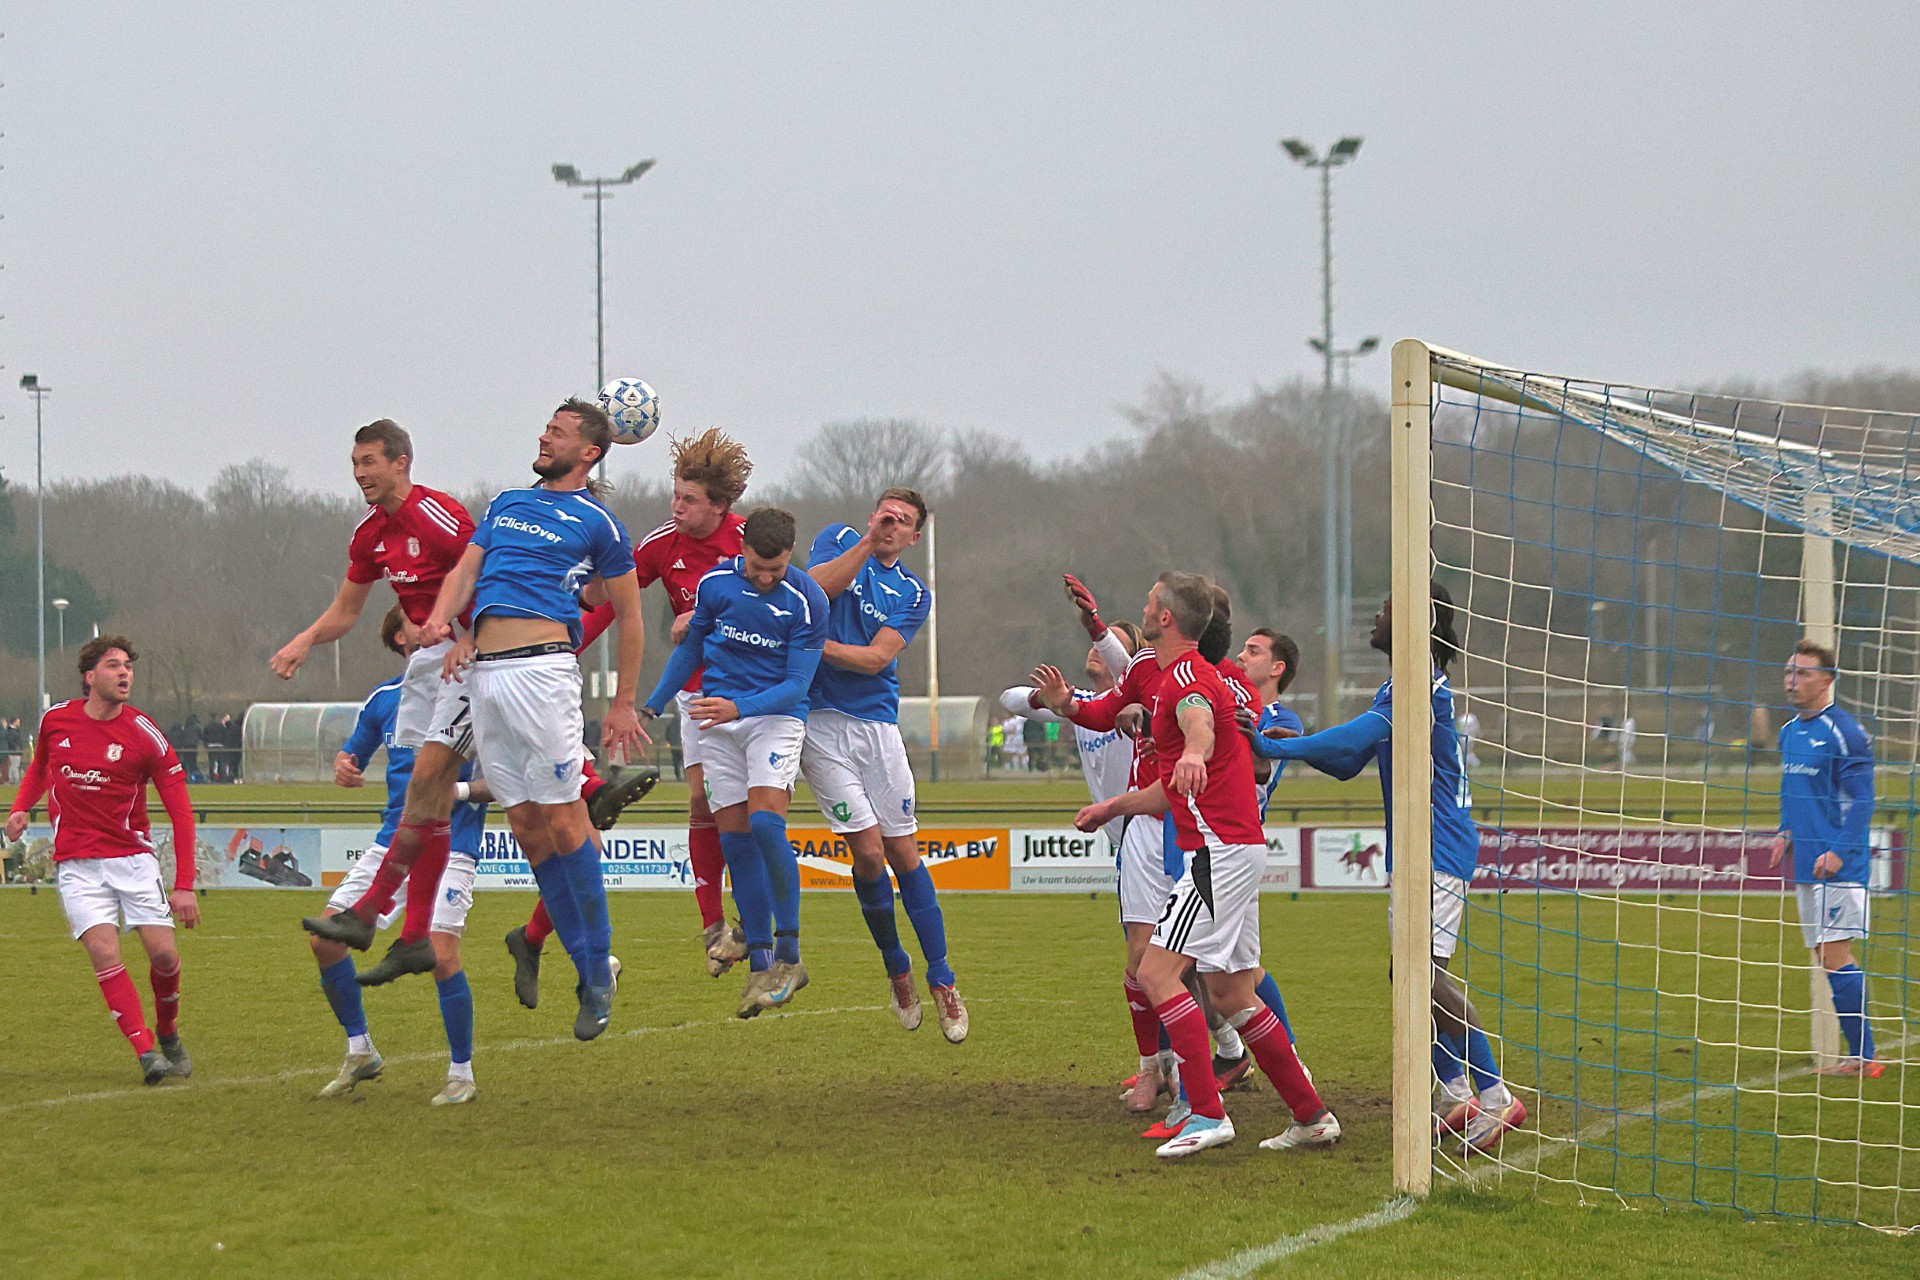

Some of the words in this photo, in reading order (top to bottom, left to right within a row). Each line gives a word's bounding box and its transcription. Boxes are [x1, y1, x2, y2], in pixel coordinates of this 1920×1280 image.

[498, 516, 563, 543] ClickOver
[723, 624, 782, 648] ClickOver
[967, 841, 997, 858] BV
[1023, 834, 1096, 862] Jutter
[509, 864, 520, 873] 16
[608, 864, 668, 873] 0255-511730
[1023, 876, 1039, 884] Uw
[1040, 875, 1062, 884] krant
